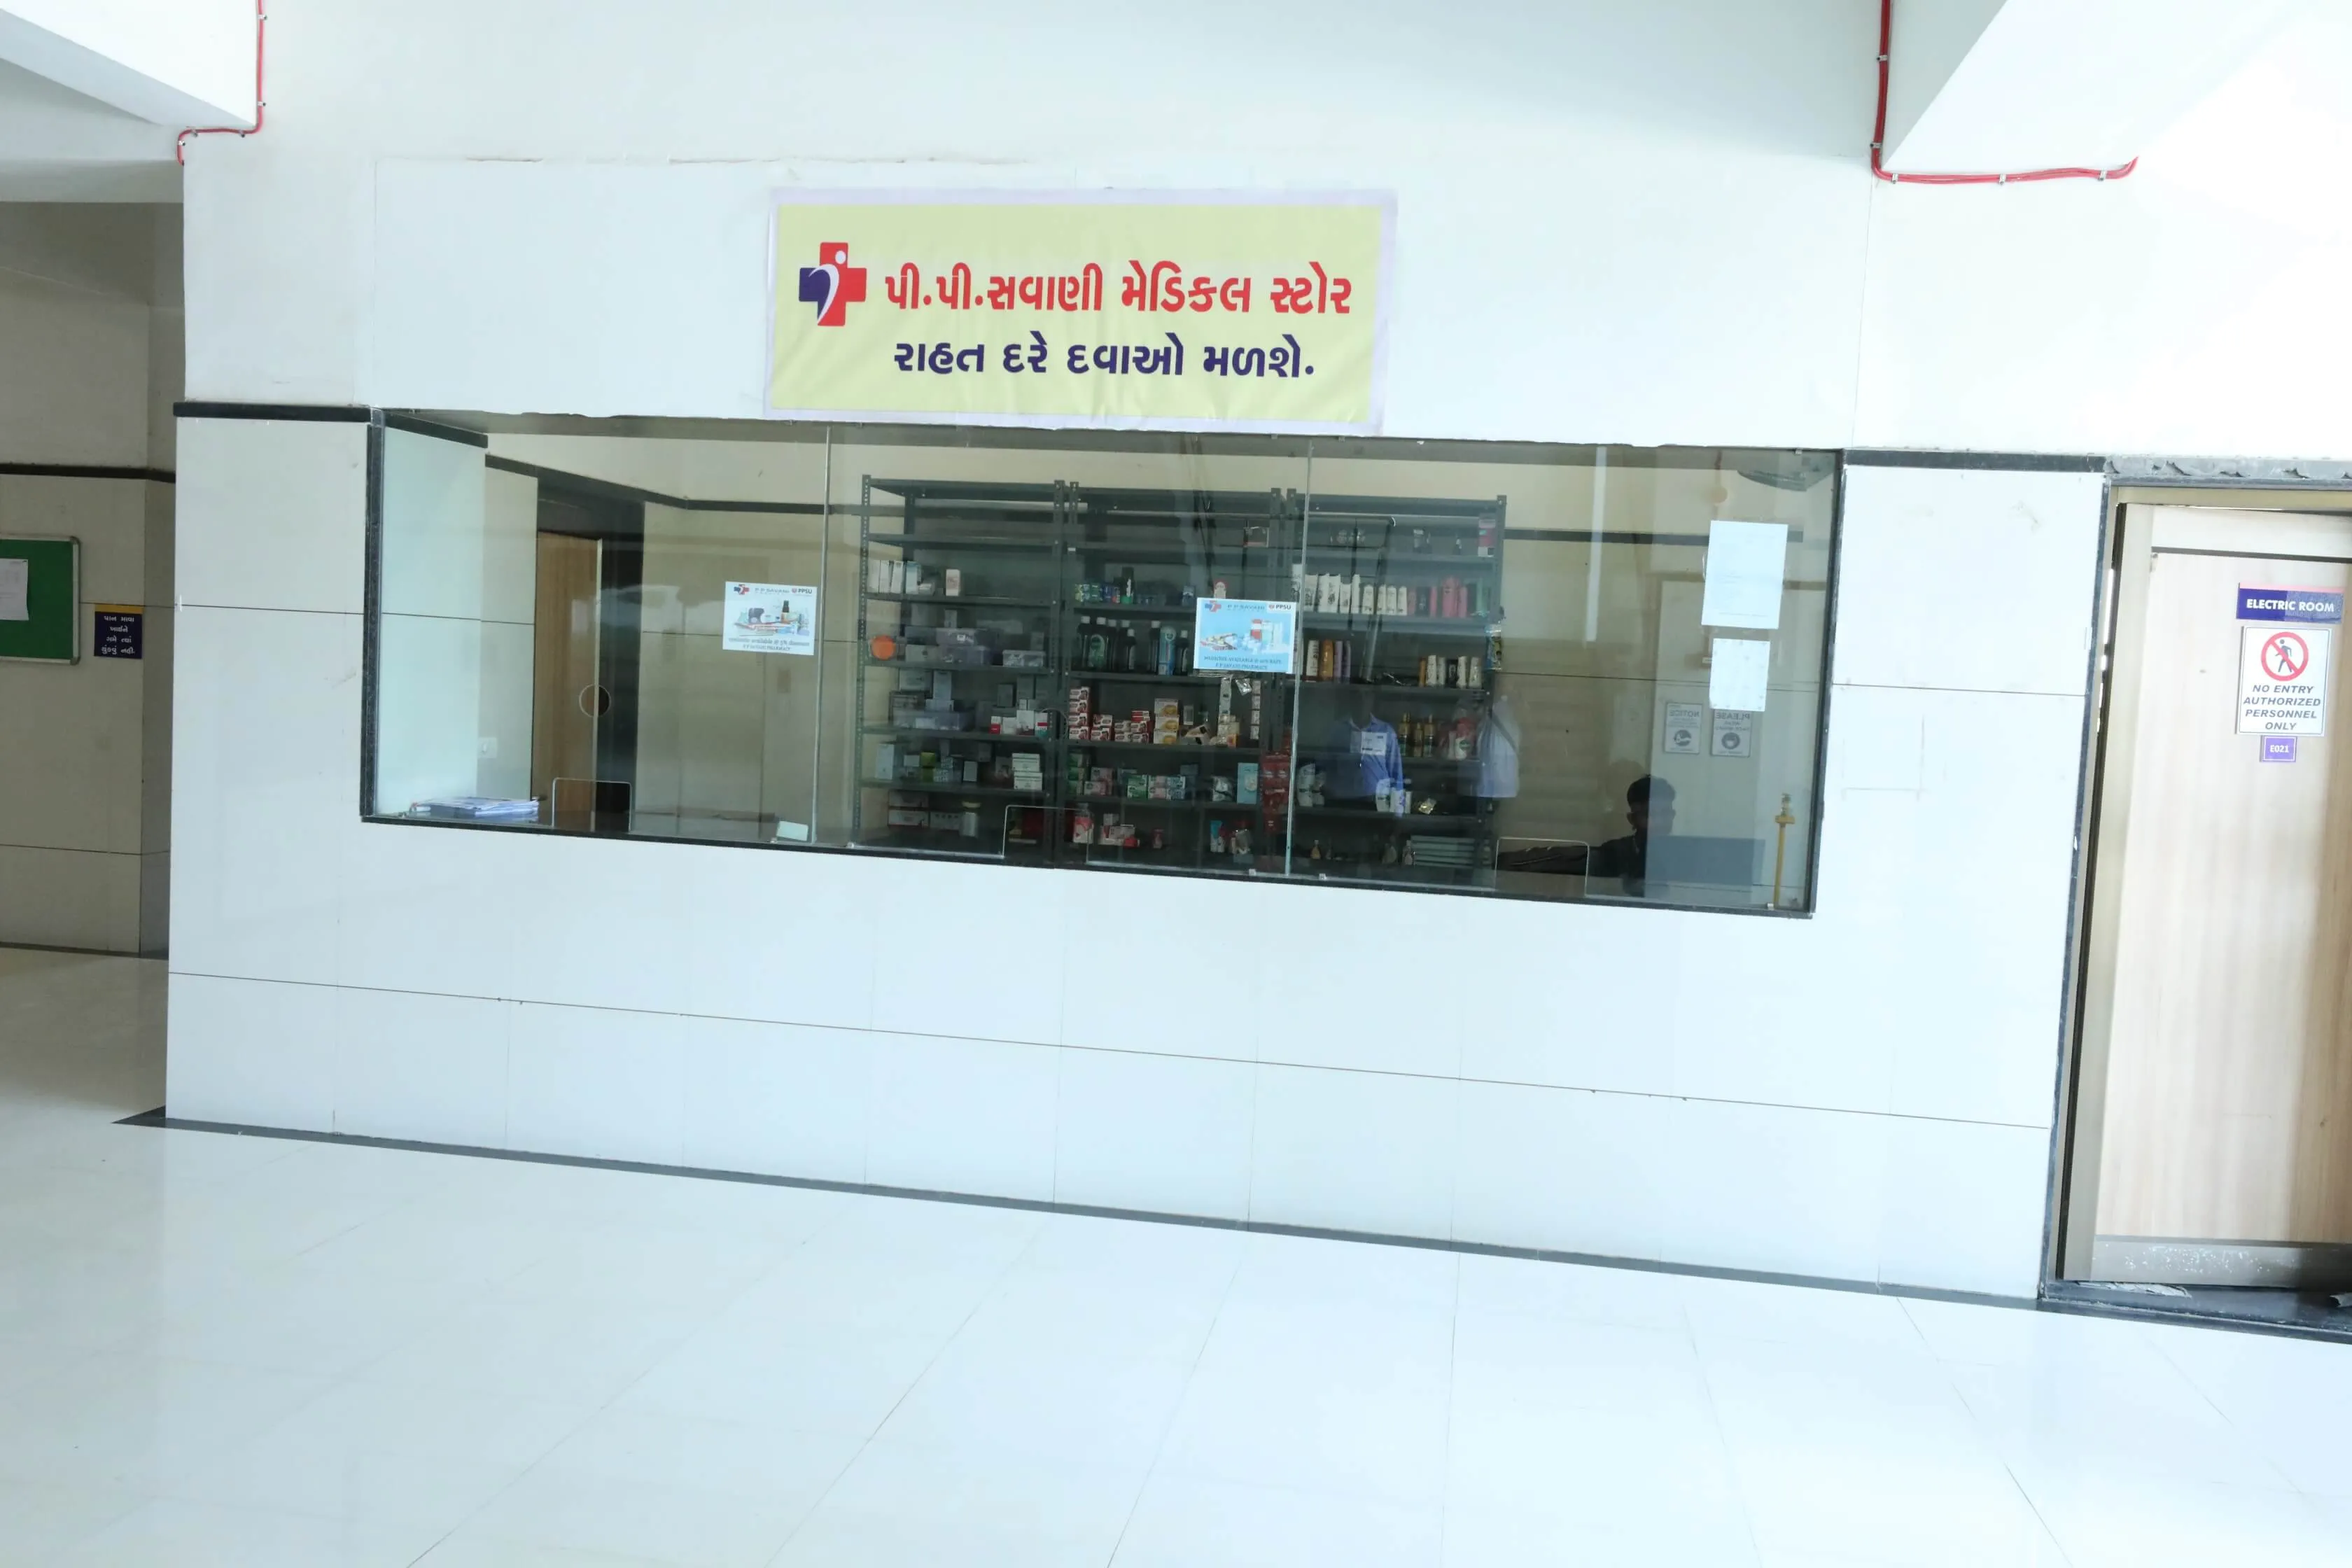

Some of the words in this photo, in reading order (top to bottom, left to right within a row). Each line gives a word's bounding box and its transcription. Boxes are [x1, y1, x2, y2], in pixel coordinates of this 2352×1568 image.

[885, 262, 1103, 312] પી.પી.સવાણી
[1121, 260, 1252, 313] મેડિકલ
[1270, 261, 1352, 314] સ્ટોર
[894, 342, 985, 374] રાહત
[1002, 330, 1048, 373] દરે
[1067, 332, 1184, 375] દવાઓ
[1203, 333, 1315, 378] મળશે.
[2246, 598, 2296, 611] ELECTRIC
[2298, 601, 2335, 612] ROOM
[2273, 685, 2314, 694] ENTRY
[2243, 696, 2321, 706] AUTHORIZED
[2245, 709, 2318, 719] PERSONNEL
[2264, 722, 2297, 731] ONLY
[2269, 744, 2290, 753] E021
